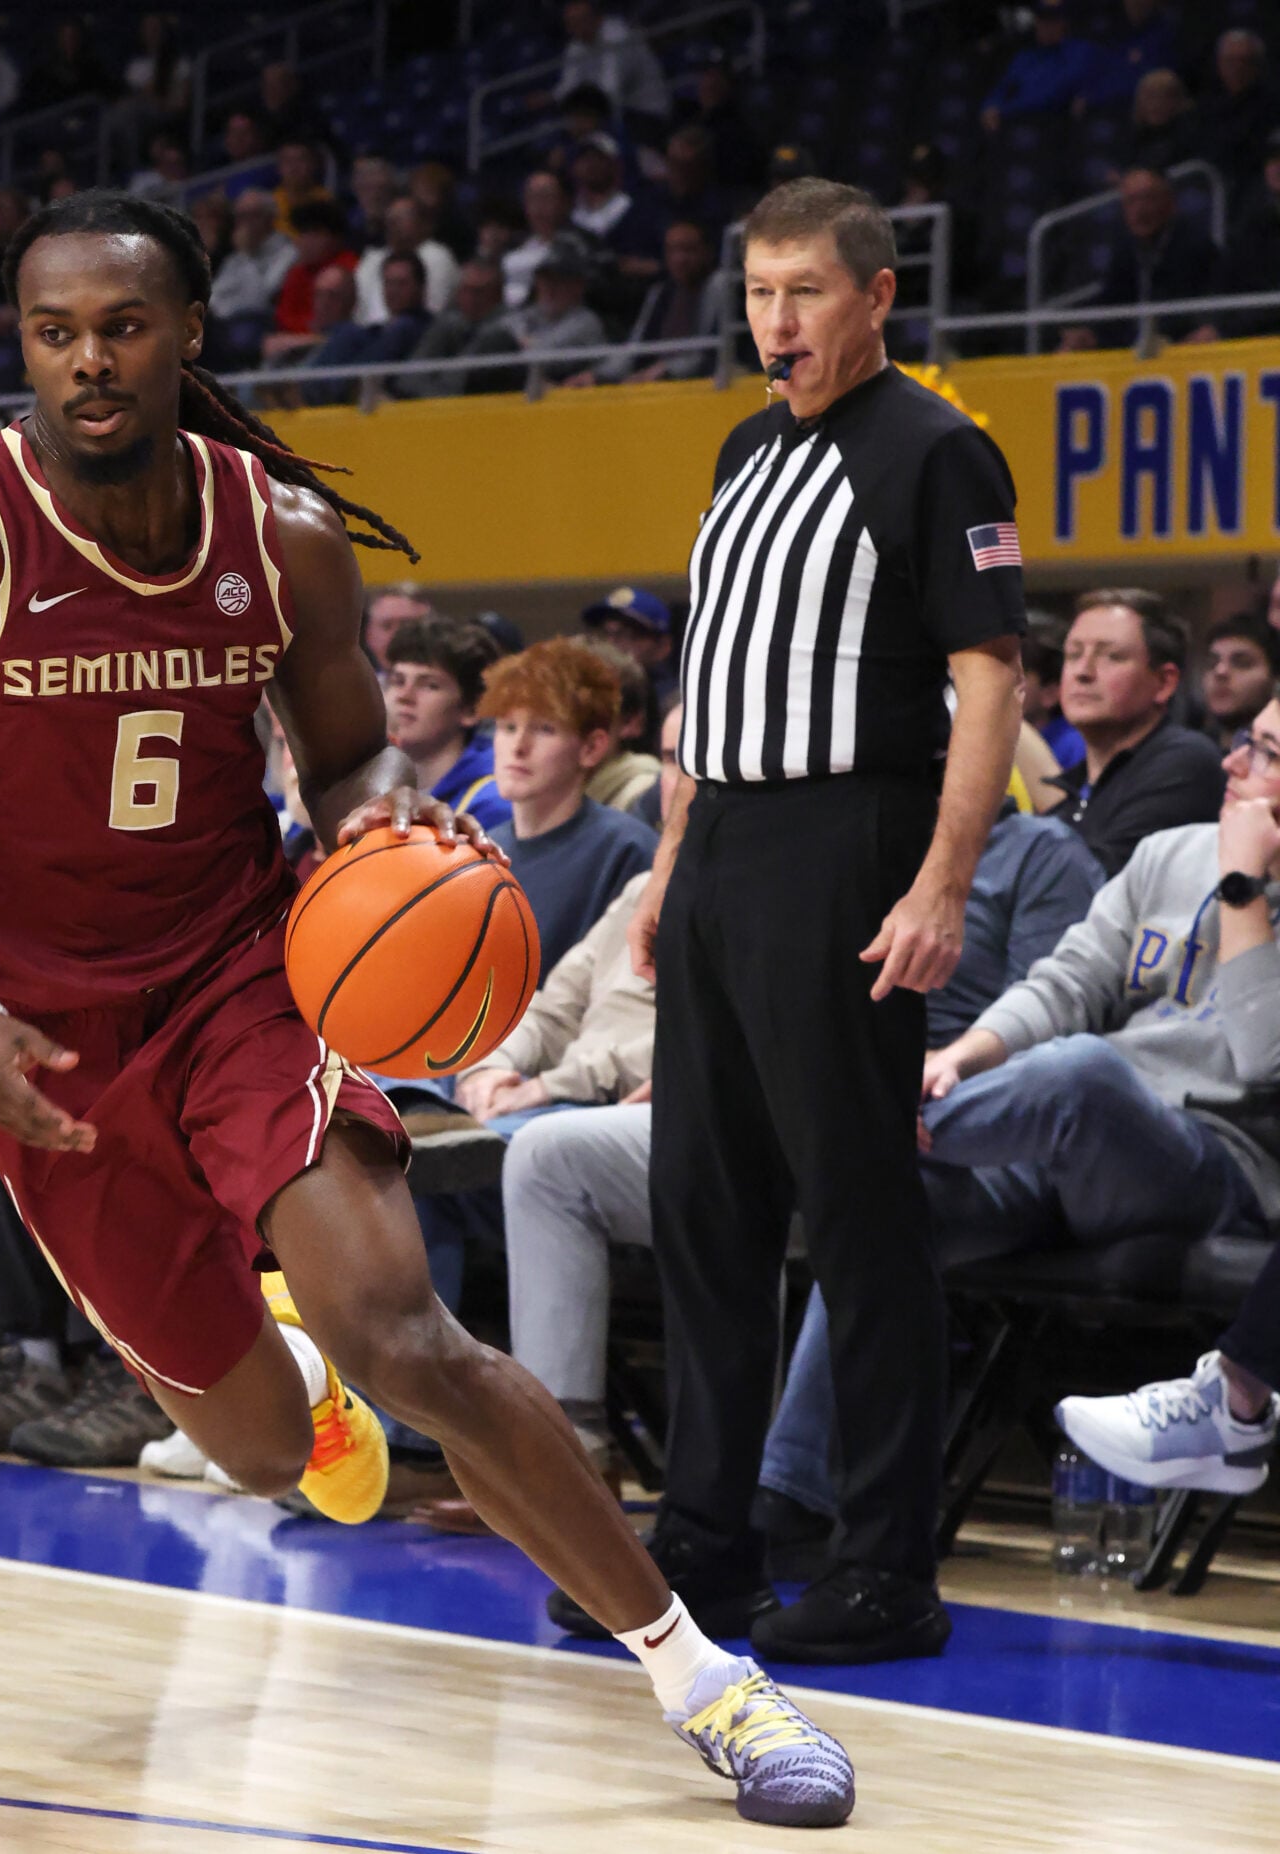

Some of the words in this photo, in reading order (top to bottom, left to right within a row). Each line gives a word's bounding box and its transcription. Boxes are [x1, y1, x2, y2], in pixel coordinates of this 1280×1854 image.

[221, 586, 246, 597] ACC
[2, 644, 280, 697] SEMINOLES
[108, 709, 184, 831] 6
